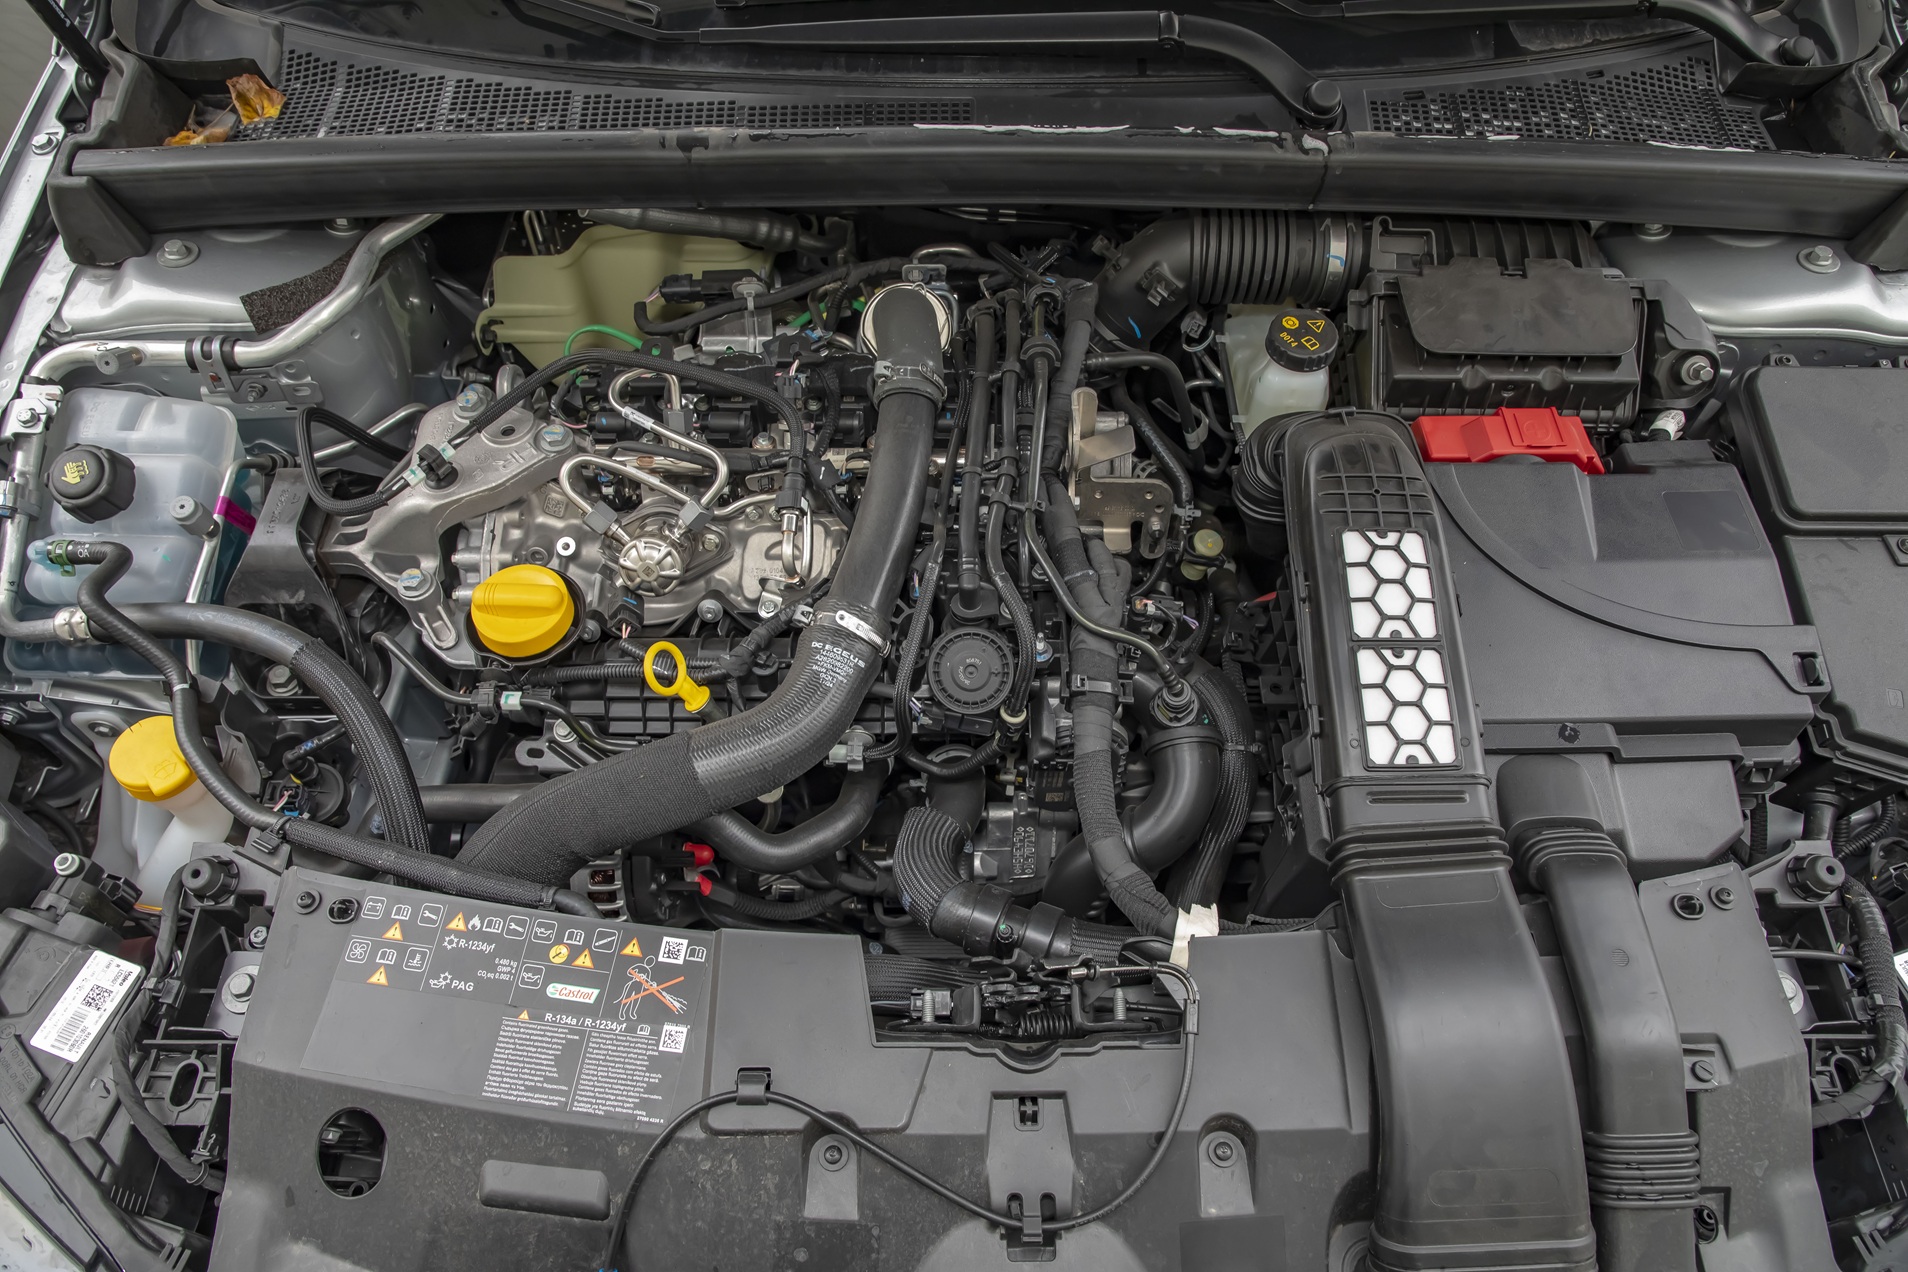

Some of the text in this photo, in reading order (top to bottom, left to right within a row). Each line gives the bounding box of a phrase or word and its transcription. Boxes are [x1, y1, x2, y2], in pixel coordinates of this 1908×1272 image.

[1280, 332, 1299, 348] DOT4
[458, 940, 496, 953] R-1234yf
[451, 980, 474, 991] PAG
[558, 986, 594, 1000] Castrol
[545, 1013, 576, 1025] R-134a
[584, 1019, 627, 1033] R-1234yf
[75, 1032, 92, 1054] RENAULT
